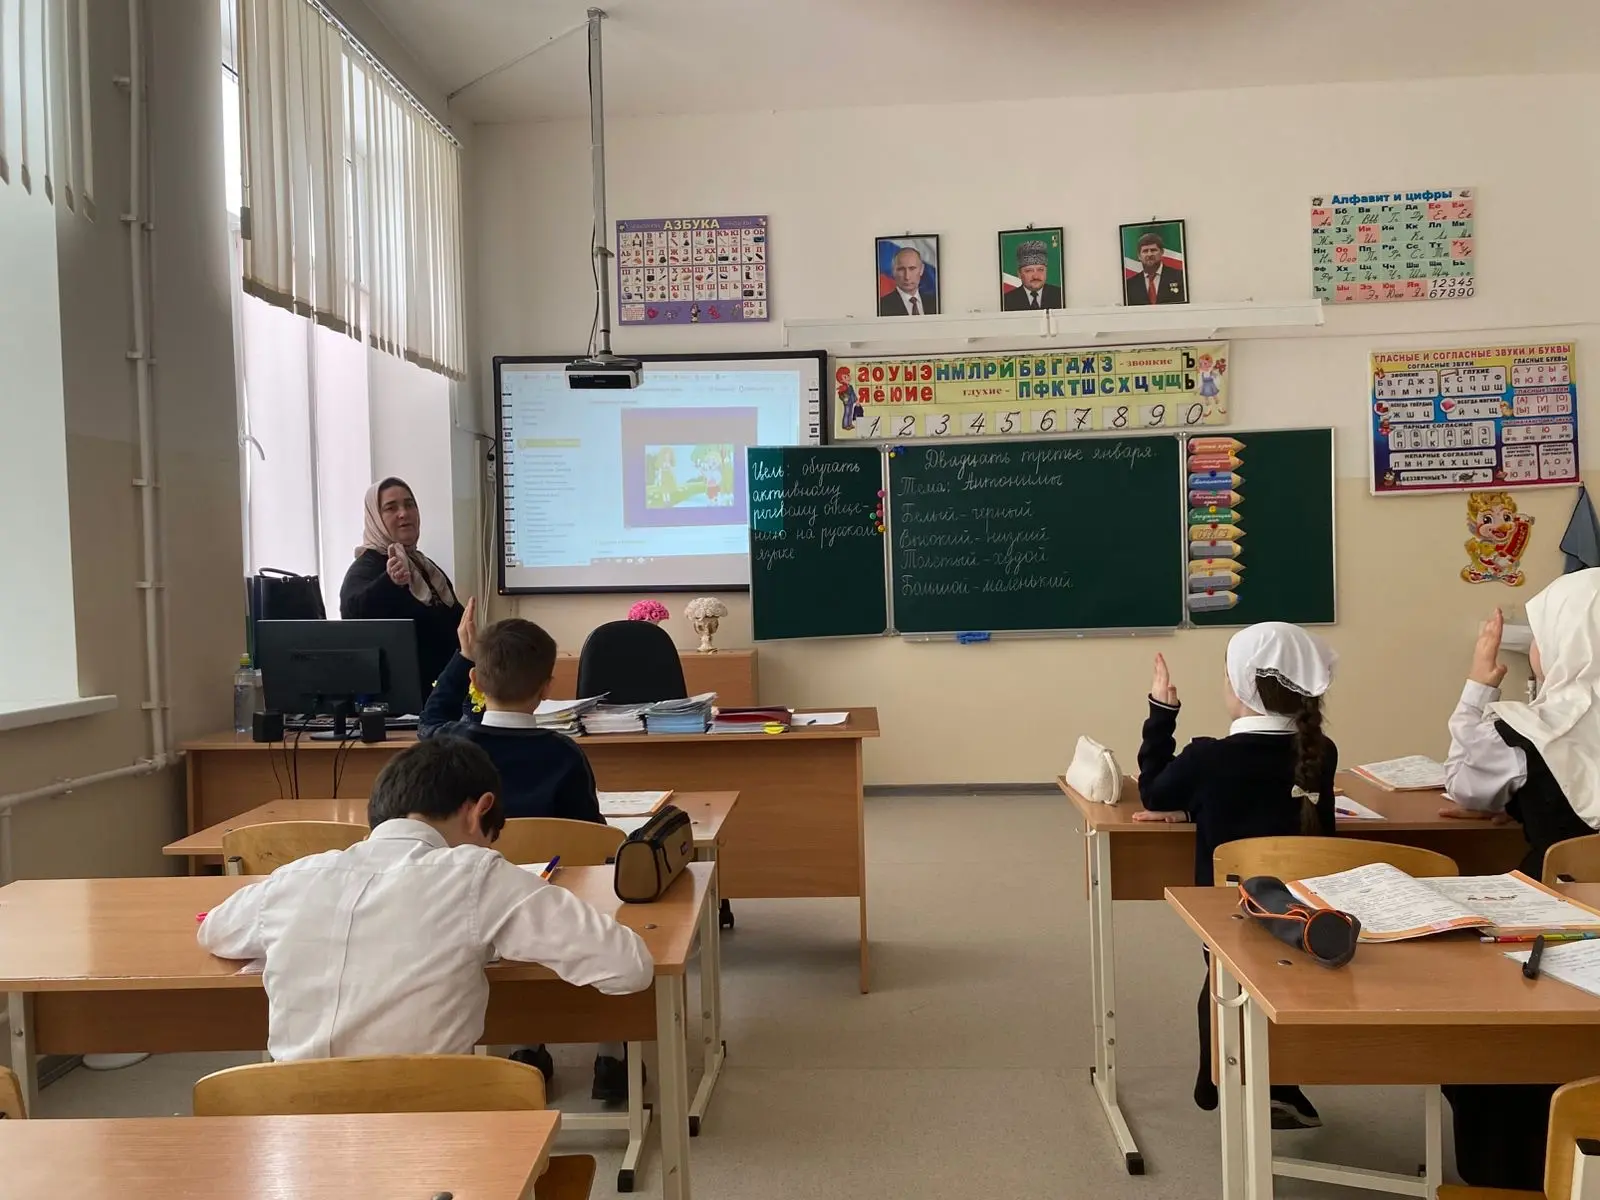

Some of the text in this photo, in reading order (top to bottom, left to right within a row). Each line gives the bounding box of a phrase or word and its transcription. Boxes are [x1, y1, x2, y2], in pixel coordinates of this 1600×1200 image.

[1331, 194, 1390, 205] Алфавит
[1405, 190, 1452, 202] цифры
[663, 218, 720, 230] АЗБУКА
[1127, 358, 1172, 368] звонкие
[1375, 354, 1420, 362] ГЛАСНЫЕ
[1433, 350, 1491, 360] СОГЛАСНЫЕ
[1495, 348, 1525, 356] ЗВУКИ
[1538, 345, 1570, 353] БУКВЫ
[962, 386, 1002, 397] глухие
[870, 403, 1203, 438] 1 2 3 4 5 6 7 8 9 0
[802, 456, 860, 486] обучать
[924, 449, 1012, 480] Двадцать
[1021, 448, 1083, 474] третье
[752, 480, 842, 505] активному
[898, 476, 950, 496] Тема:
[753, 500, 818, 530] речевому
[901, 502, 958, 523] Белый
[796, 528, 815, 540] на
[821, 526, 878, 548] русском
[900, 528, 974, 548] Высокий
[986, 527, 1049, 556] низкий
[757, 548, 795, 570] языке
[900, 548, 980, 570] Толстый
[993, 546, 1048, 575] худой
[901, 574, 970, 596] Большой
[982, 570, 1072, 594] маленький
